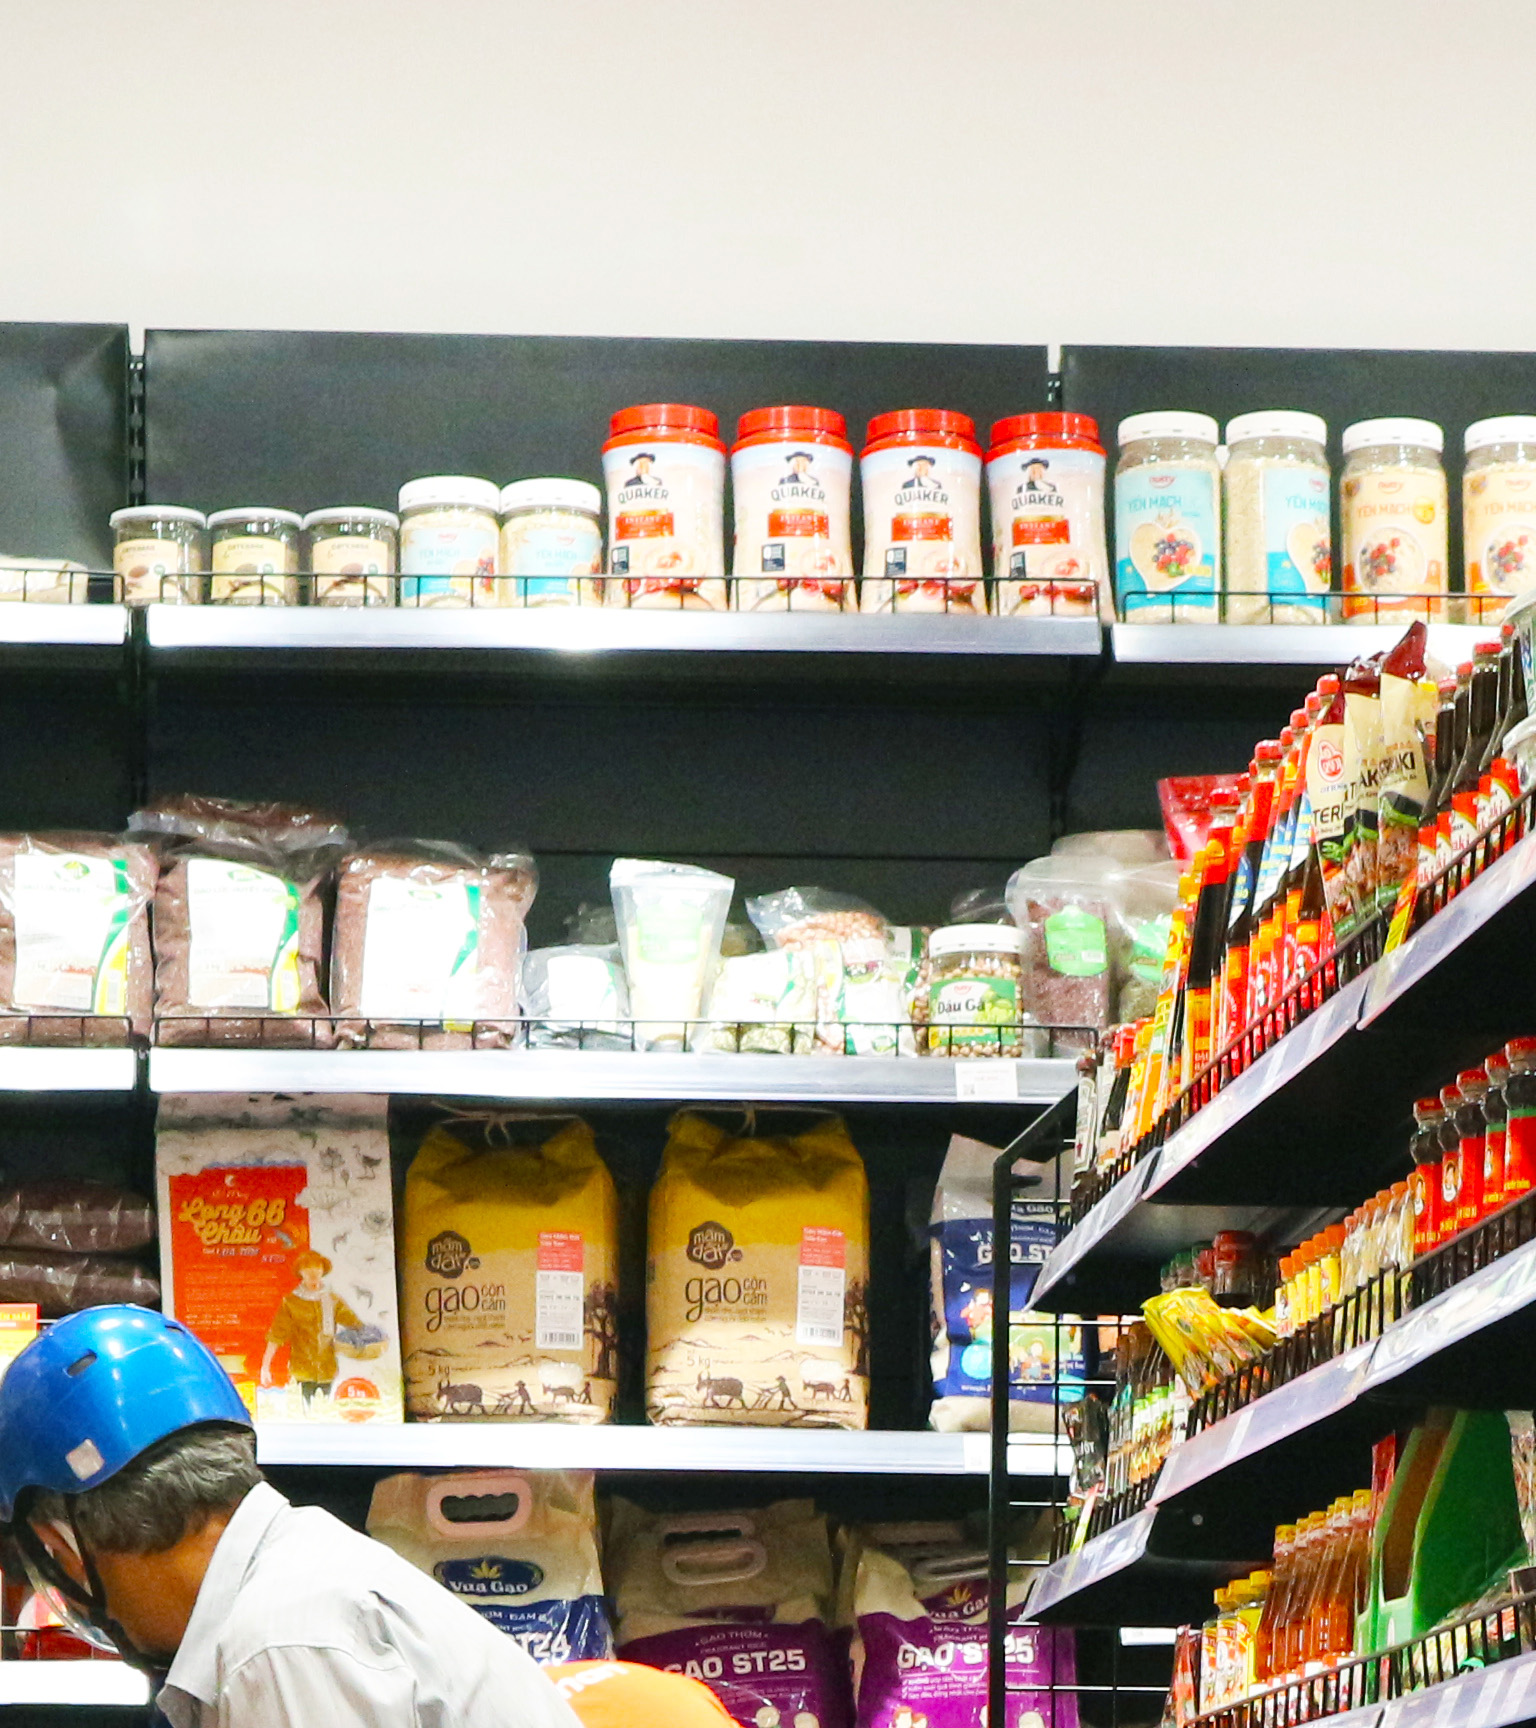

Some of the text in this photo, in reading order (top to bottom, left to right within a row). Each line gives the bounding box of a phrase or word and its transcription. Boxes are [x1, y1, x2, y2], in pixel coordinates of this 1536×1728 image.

[618, 488, 669, 503] QUAKER
[771, 487, 826, 503] QUAKER
[894, 491, 949, 507] QUAKER
[1011, 491, 1065, 510] QUAKER
[733, 1649, 807, 1674] ST25
